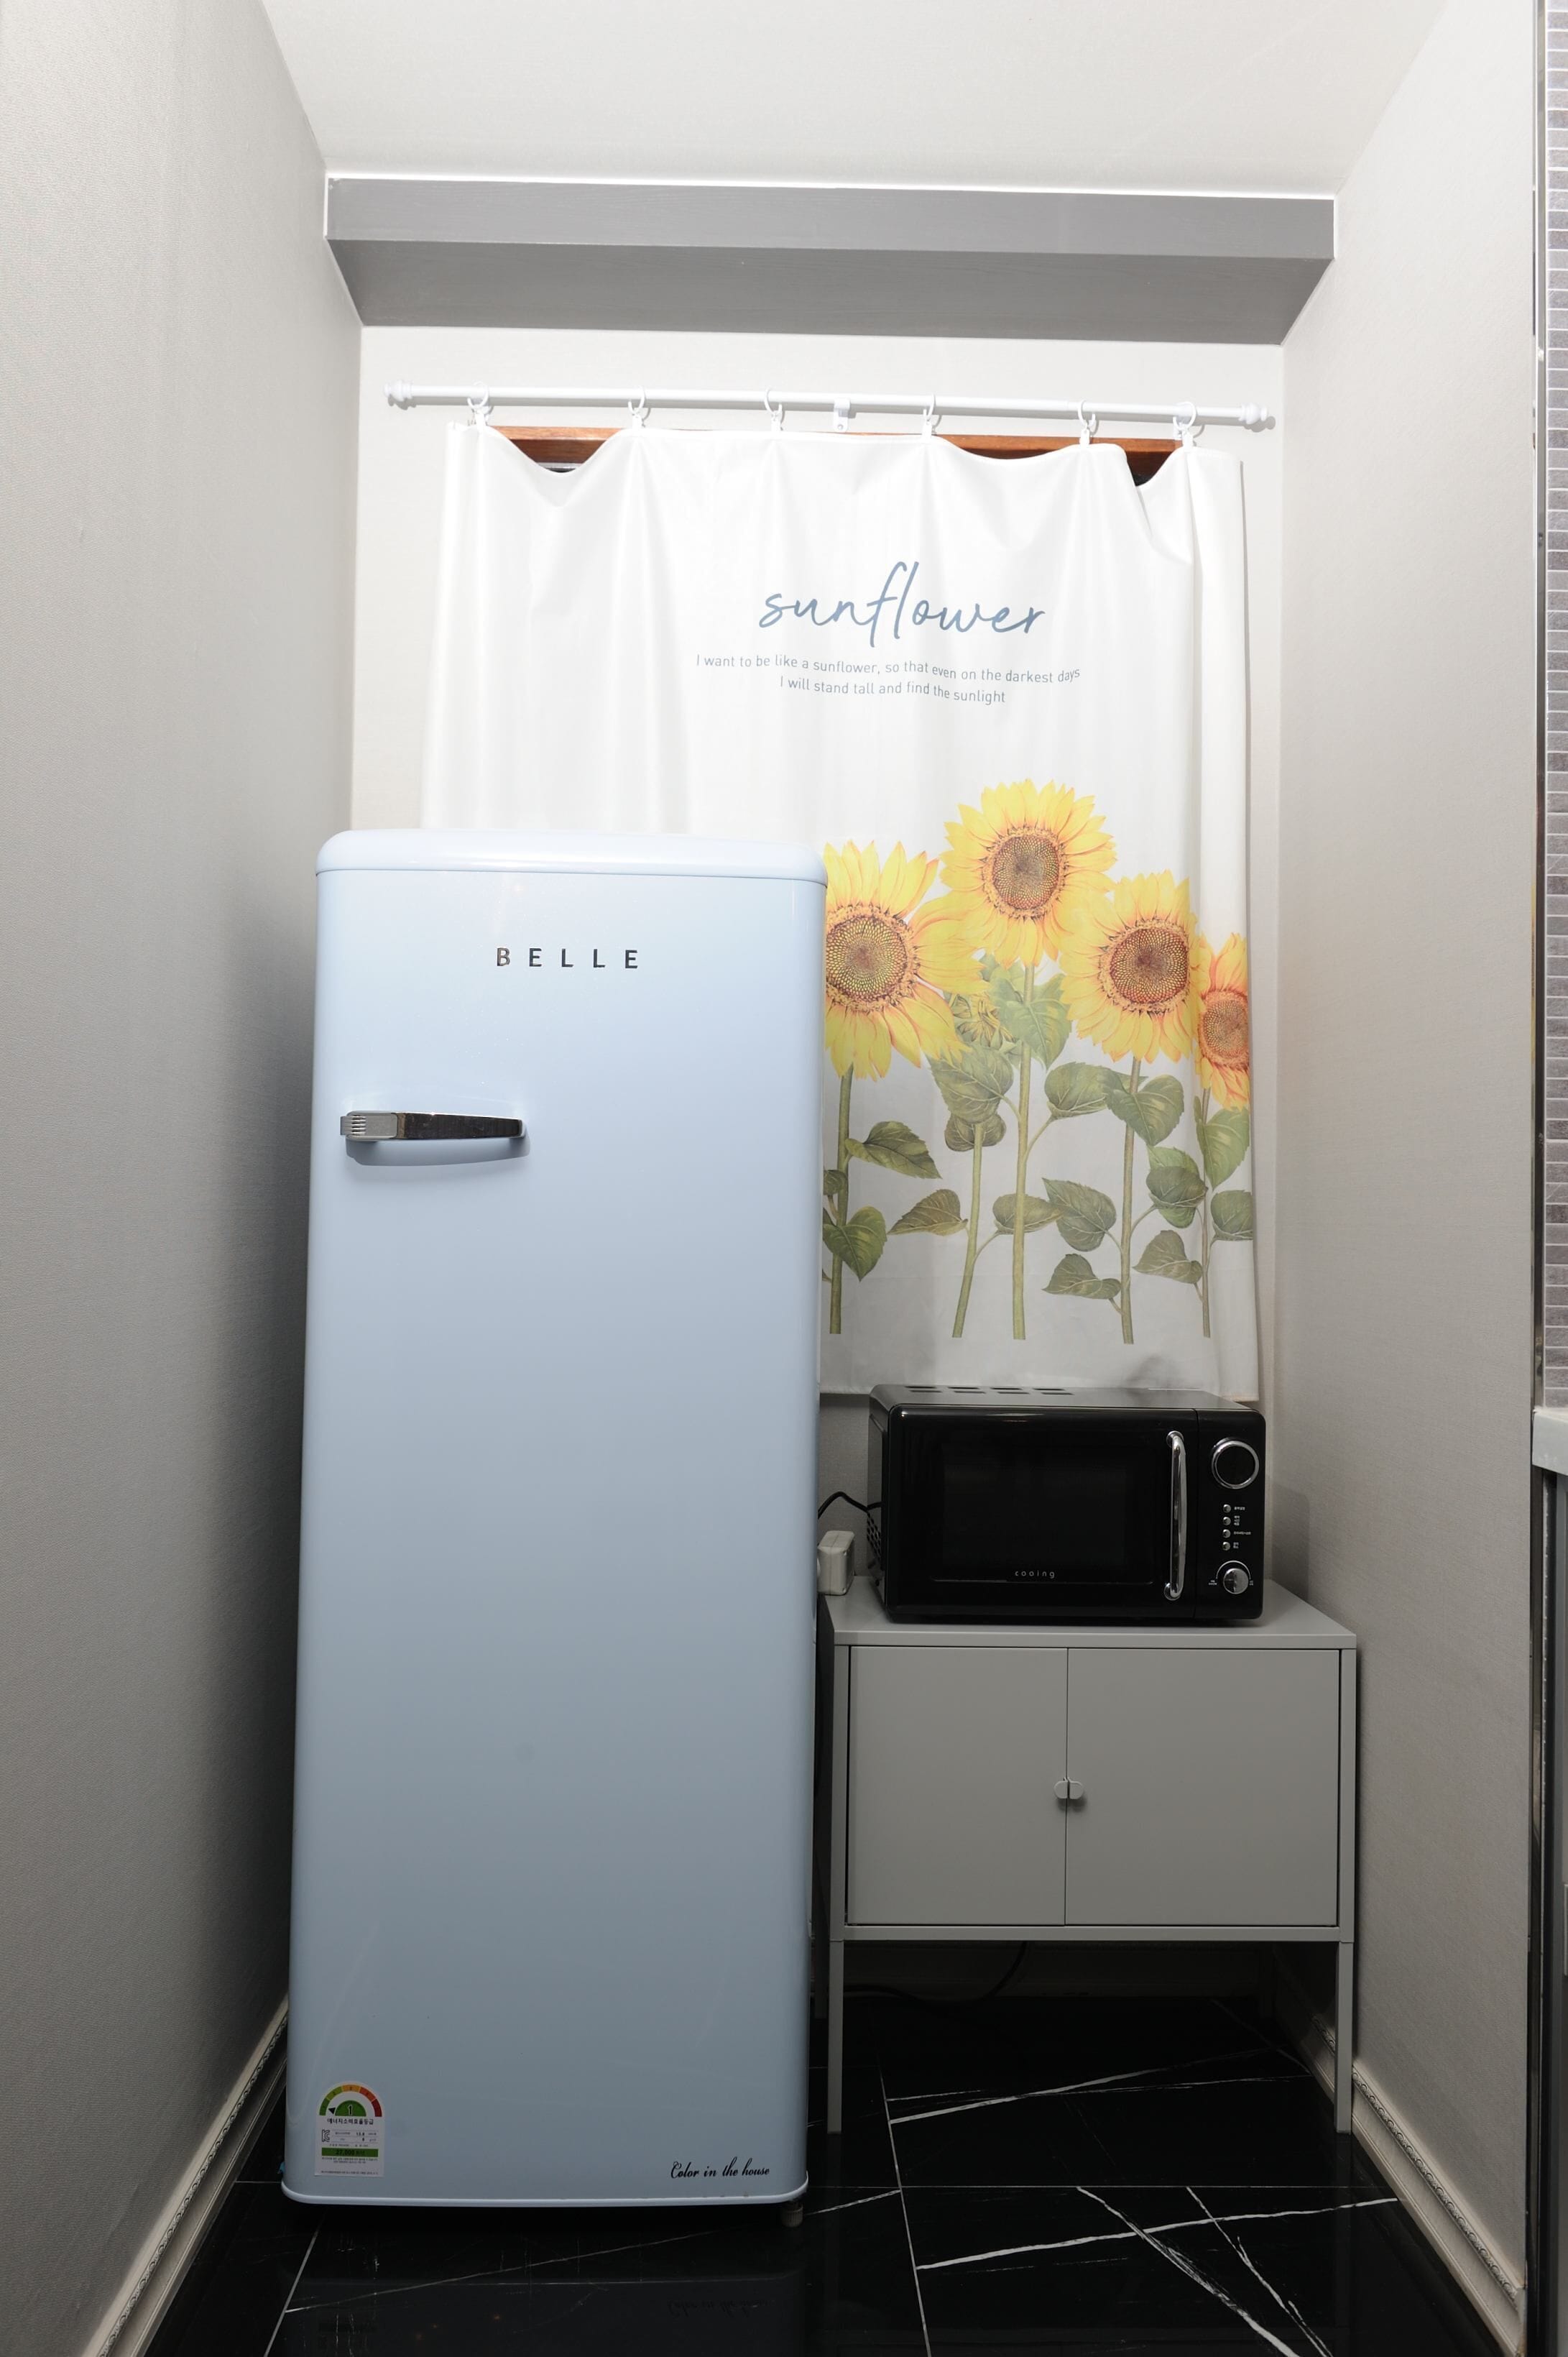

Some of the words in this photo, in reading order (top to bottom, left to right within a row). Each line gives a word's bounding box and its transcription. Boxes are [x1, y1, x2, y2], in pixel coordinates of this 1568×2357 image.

[758, 561, 1046, 648] sunflower
[704, 656, 735, 668] want
[739, 655, 752, 668] to
[755, 654, 770, 667] be
[775, 653, 798, 668] like
[801, 658, 809, 669] a
[813, 660, 880, 676] sunflower,
[885, 663, 900, 674] so
[903, 660, 929, 674] that
[931, 664, 956, 679] even
[961, 669, 977, 681] on
[981, 668, 1002, 681] the
[1005, 668, 1053, 684] darkest
[1057, 668, 1082, 684] days
[788, 677, 811, 691] will
[813, 680, 849, 694] stand
[853, 681, 875, 695] tall
[878, 681, 902, 694] and
[906, 681, 931, 695] find
[933, 684, 951, 700] the
[953, 689, 1007, 707] sunlight
[496, 947, 639, 970] BELLE
[670, 2161, 700, 2179] Color
[704, 2165, 717, 2177] in
[721, 2156, 739, 2177] the
[741, 2157, 770, 2177] house
